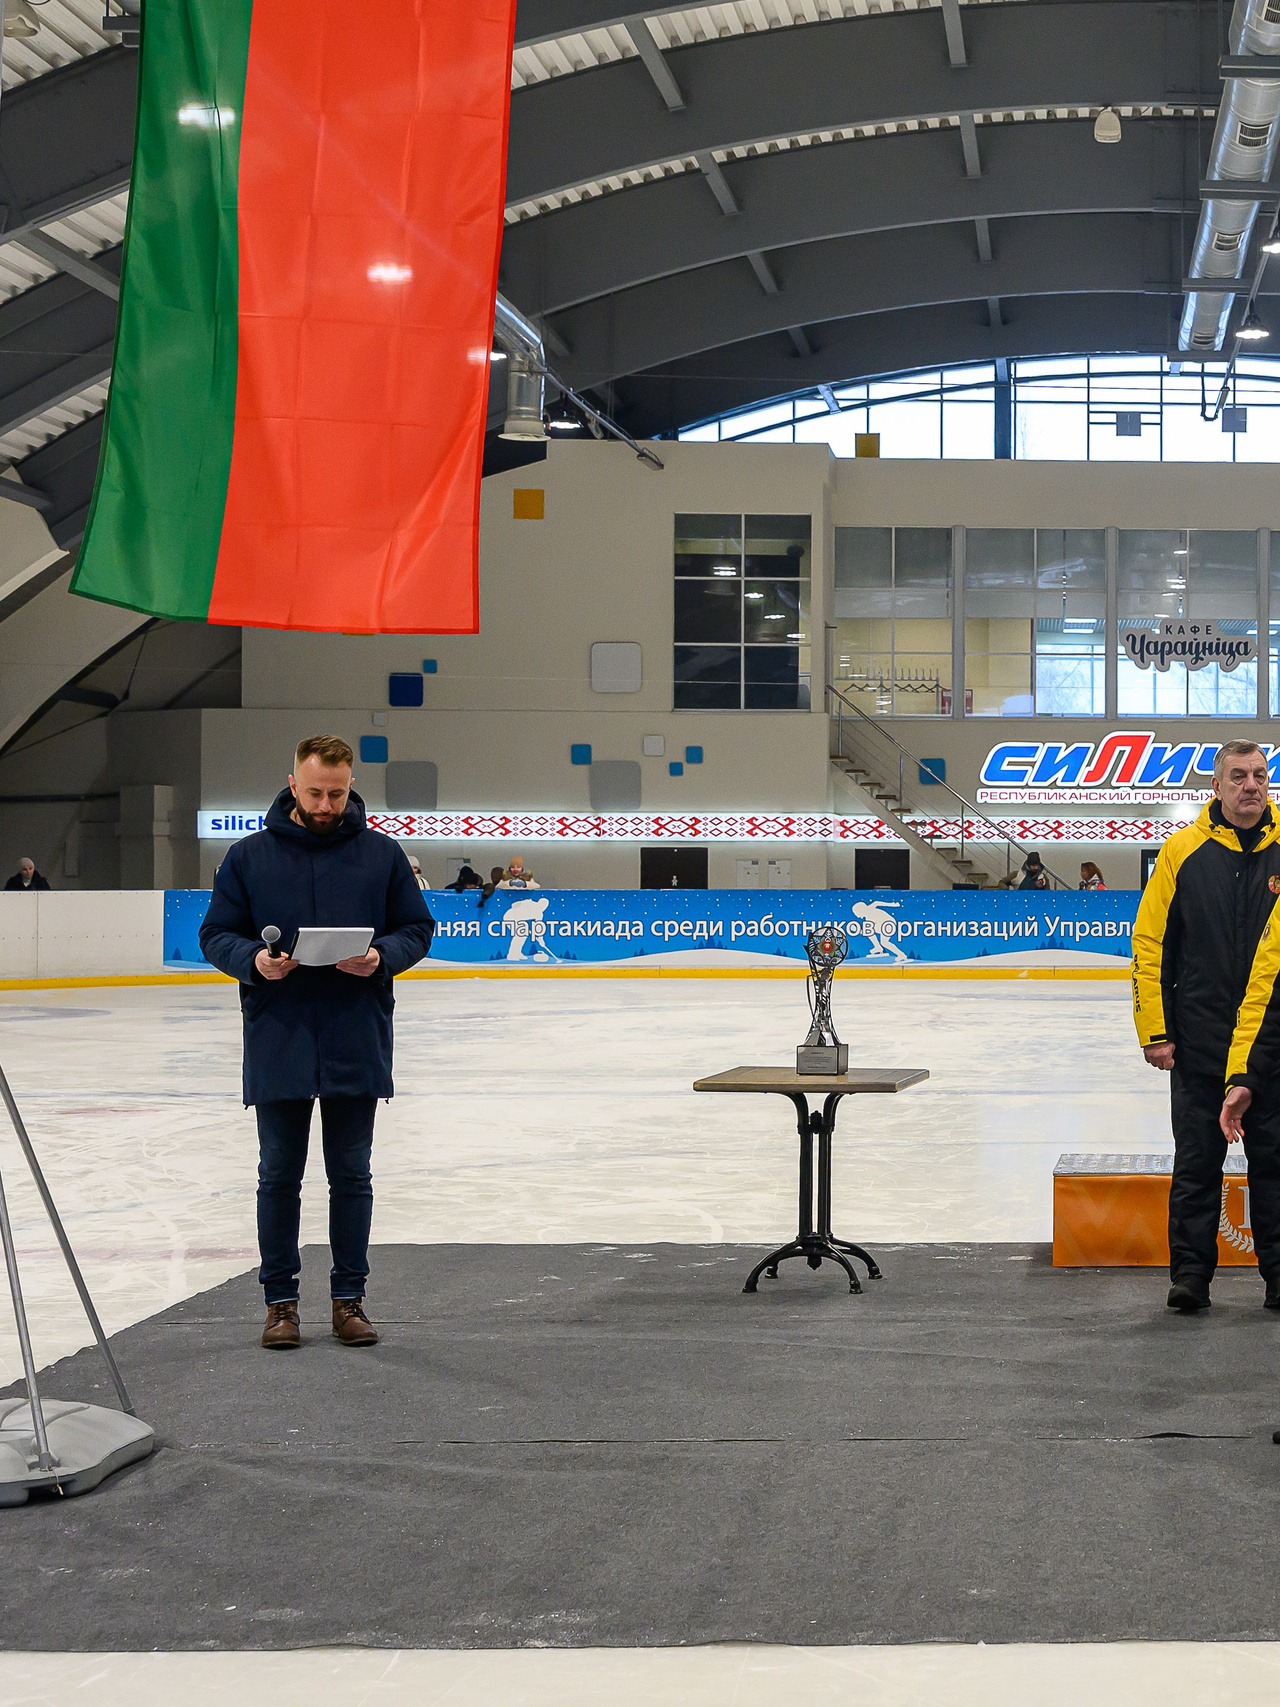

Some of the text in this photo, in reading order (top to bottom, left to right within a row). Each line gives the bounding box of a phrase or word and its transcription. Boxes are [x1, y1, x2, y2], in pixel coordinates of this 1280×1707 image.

[1165, 624, 1212, 635] КАФЕ
[1126, 633, 1252, 667] Чараўніца
[980, 790, 1131, 801] РЕСПУБЛИКАНСКИЙ
[433, 920, 480, 937] няя
[487, 920, 644, 942] спартакиада
[651, 920, 723, 942] среди
[880, 915, 1039, 942] организаций
[1044, 916, 1135, 942] Управл
